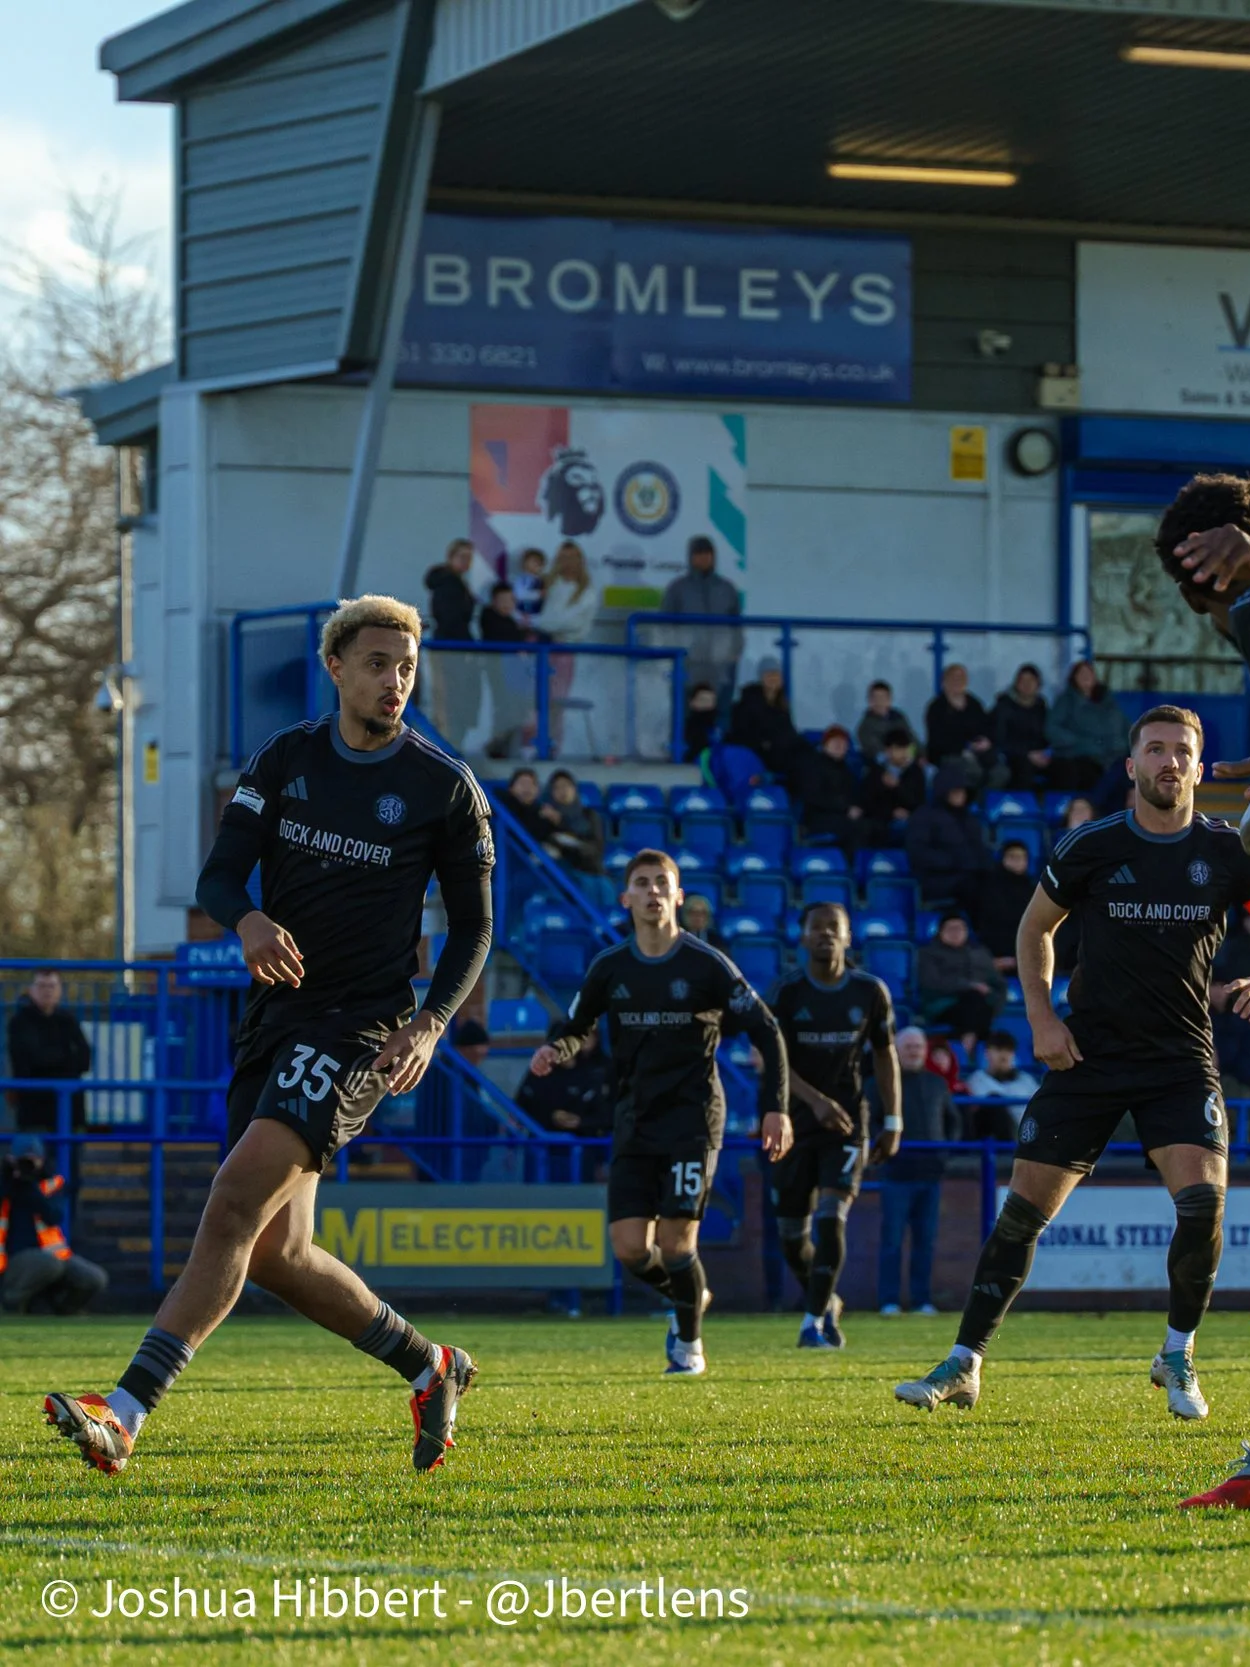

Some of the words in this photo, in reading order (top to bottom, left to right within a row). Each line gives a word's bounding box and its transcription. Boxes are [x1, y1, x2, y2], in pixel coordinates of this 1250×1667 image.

[424, 254, 896, 325] BROMLEYS
[310, 829, 343, 853] AND
[343, 838, 392, 867] COVER
[1145, 903, 1171, 919] AND
[1174, 905, 1211, 921] COVER
[643, 1011, 661, 1025] AND
[661, 1011, 693, 1024] COVER
[277, 1043, 342, 1102] 35
[842, 1145, 859, 1174] 7
[671, 1162, 702, 1197] 15
[390, 1223, 594, 1251] ELECTRICAL
